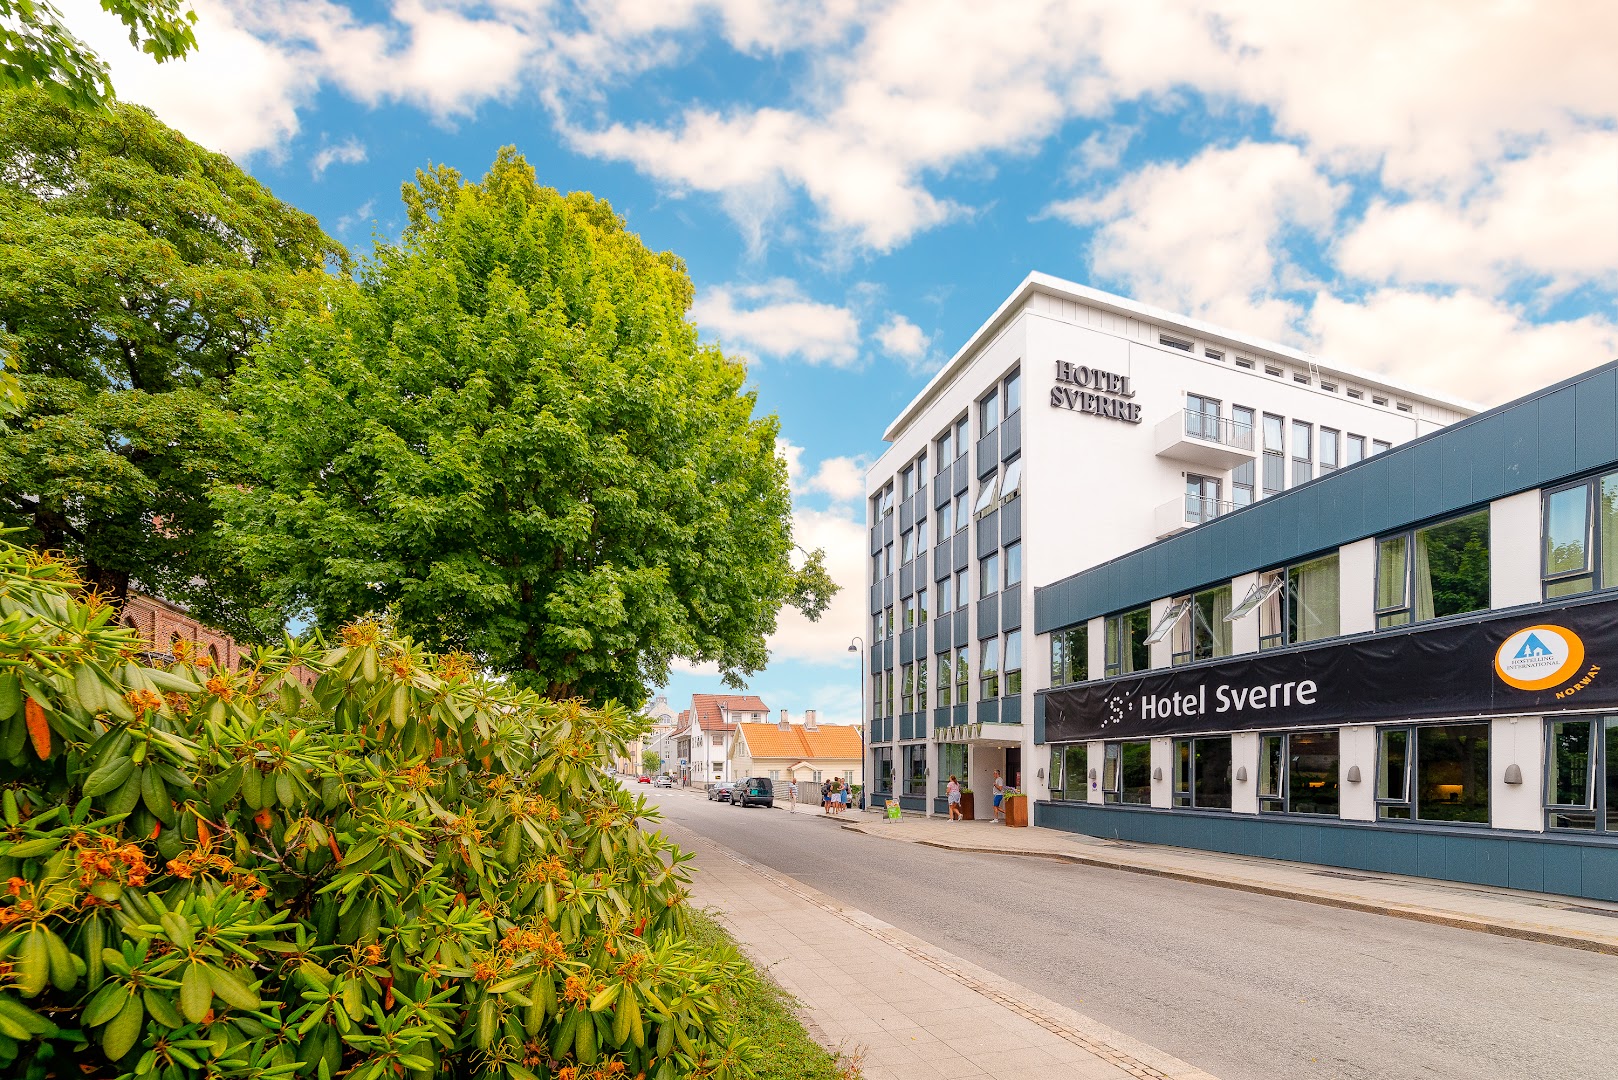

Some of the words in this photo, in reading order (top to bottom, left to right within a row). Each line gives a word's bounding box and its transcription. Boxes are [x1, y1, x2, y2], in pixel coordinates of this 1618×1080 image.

[1055, 360, 1136, 399] HOTEL
[1050, 385, 1142, 424] SVERRE
[1506, 660, 1560, 670] INTERNATIONAL
[1511, 656, 1554, 665] HOSTELLING
[1141, 685, 1205, 719] Hotel
[1216, 680, 1317, 713] Sverre
[1555, 664, 1601, 700] NORWAY
